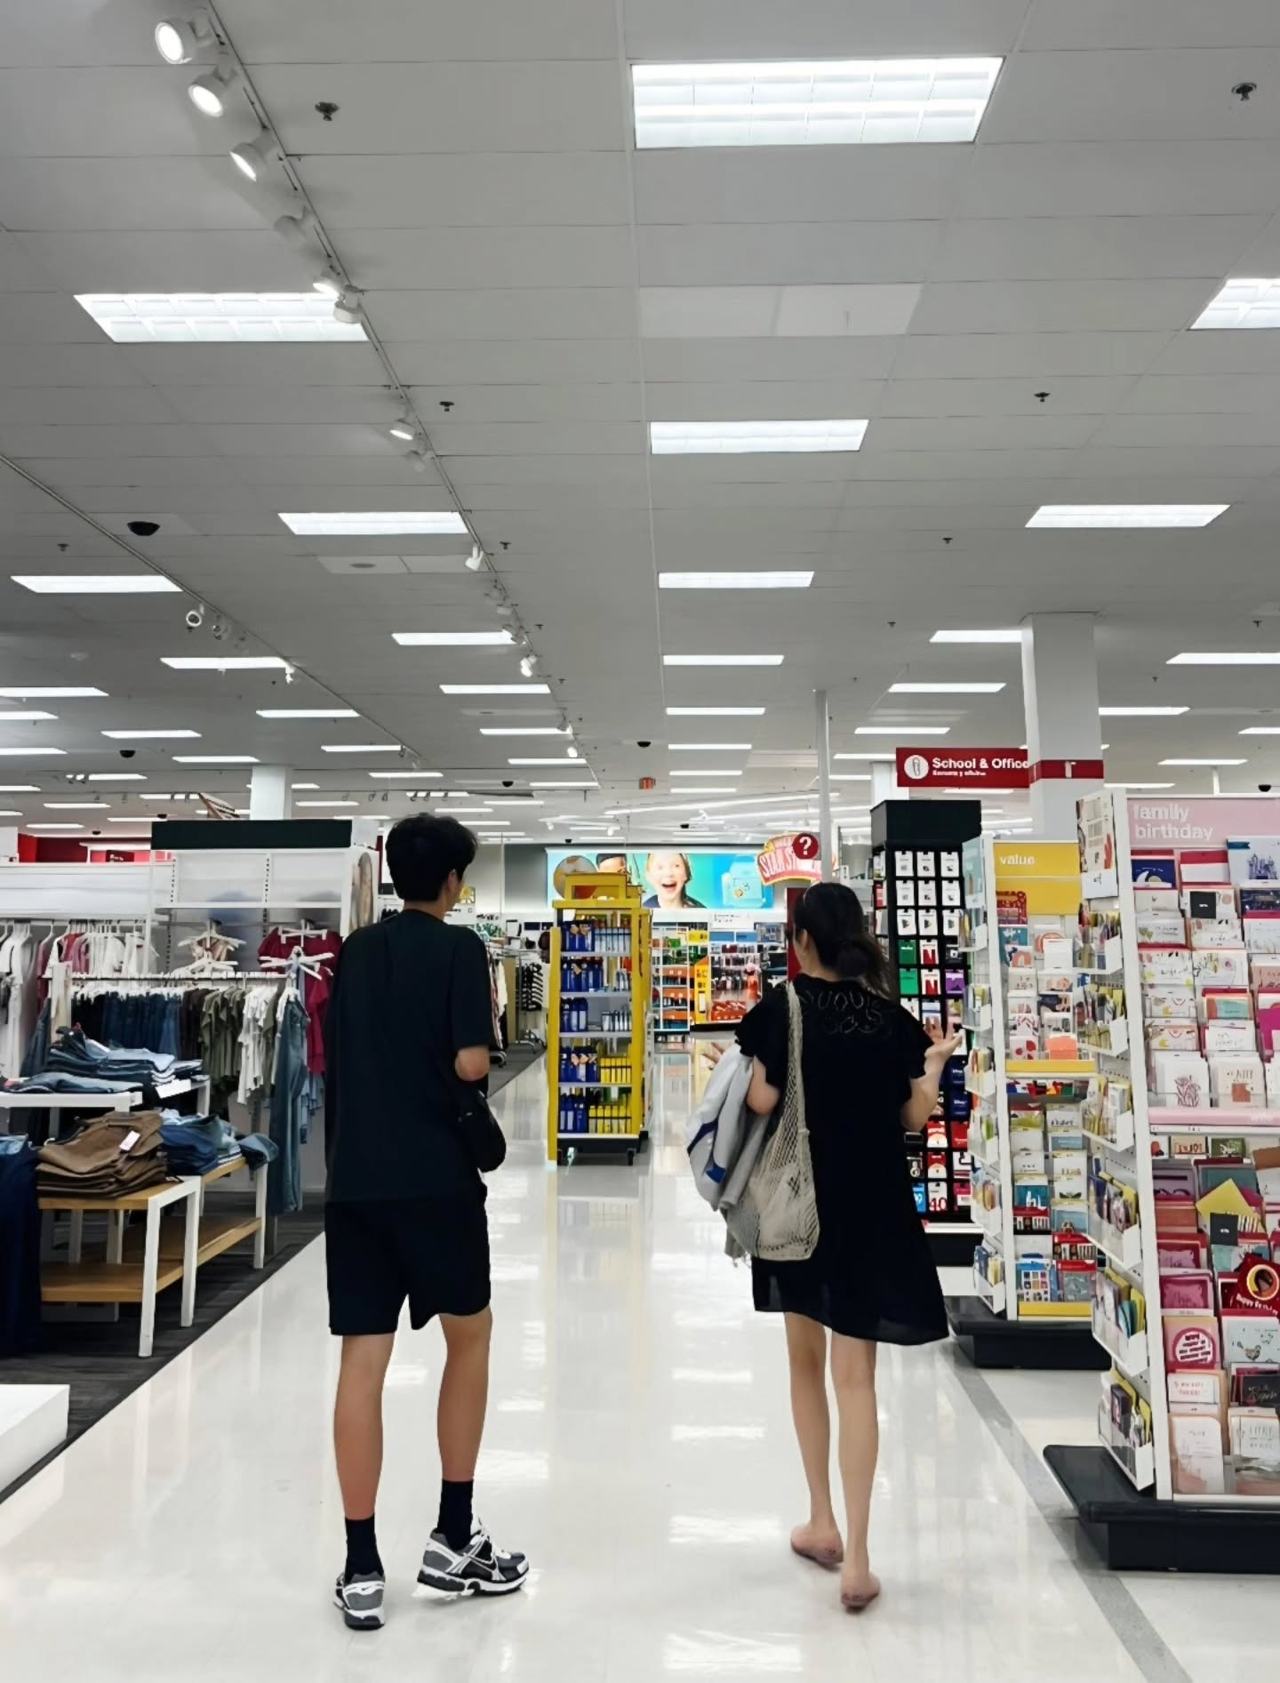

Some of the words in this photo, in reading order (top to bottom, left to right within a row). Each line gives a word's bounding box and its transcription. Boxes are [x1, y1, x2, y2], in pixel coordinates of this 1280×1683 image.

[932, 758, 976, 769] School
[980, 758, 989, 769] &
[1133, 803, 1189, 822] family
[1135, 824, 1213, 841] birthday
[1000, 853, 1035, 865] value
